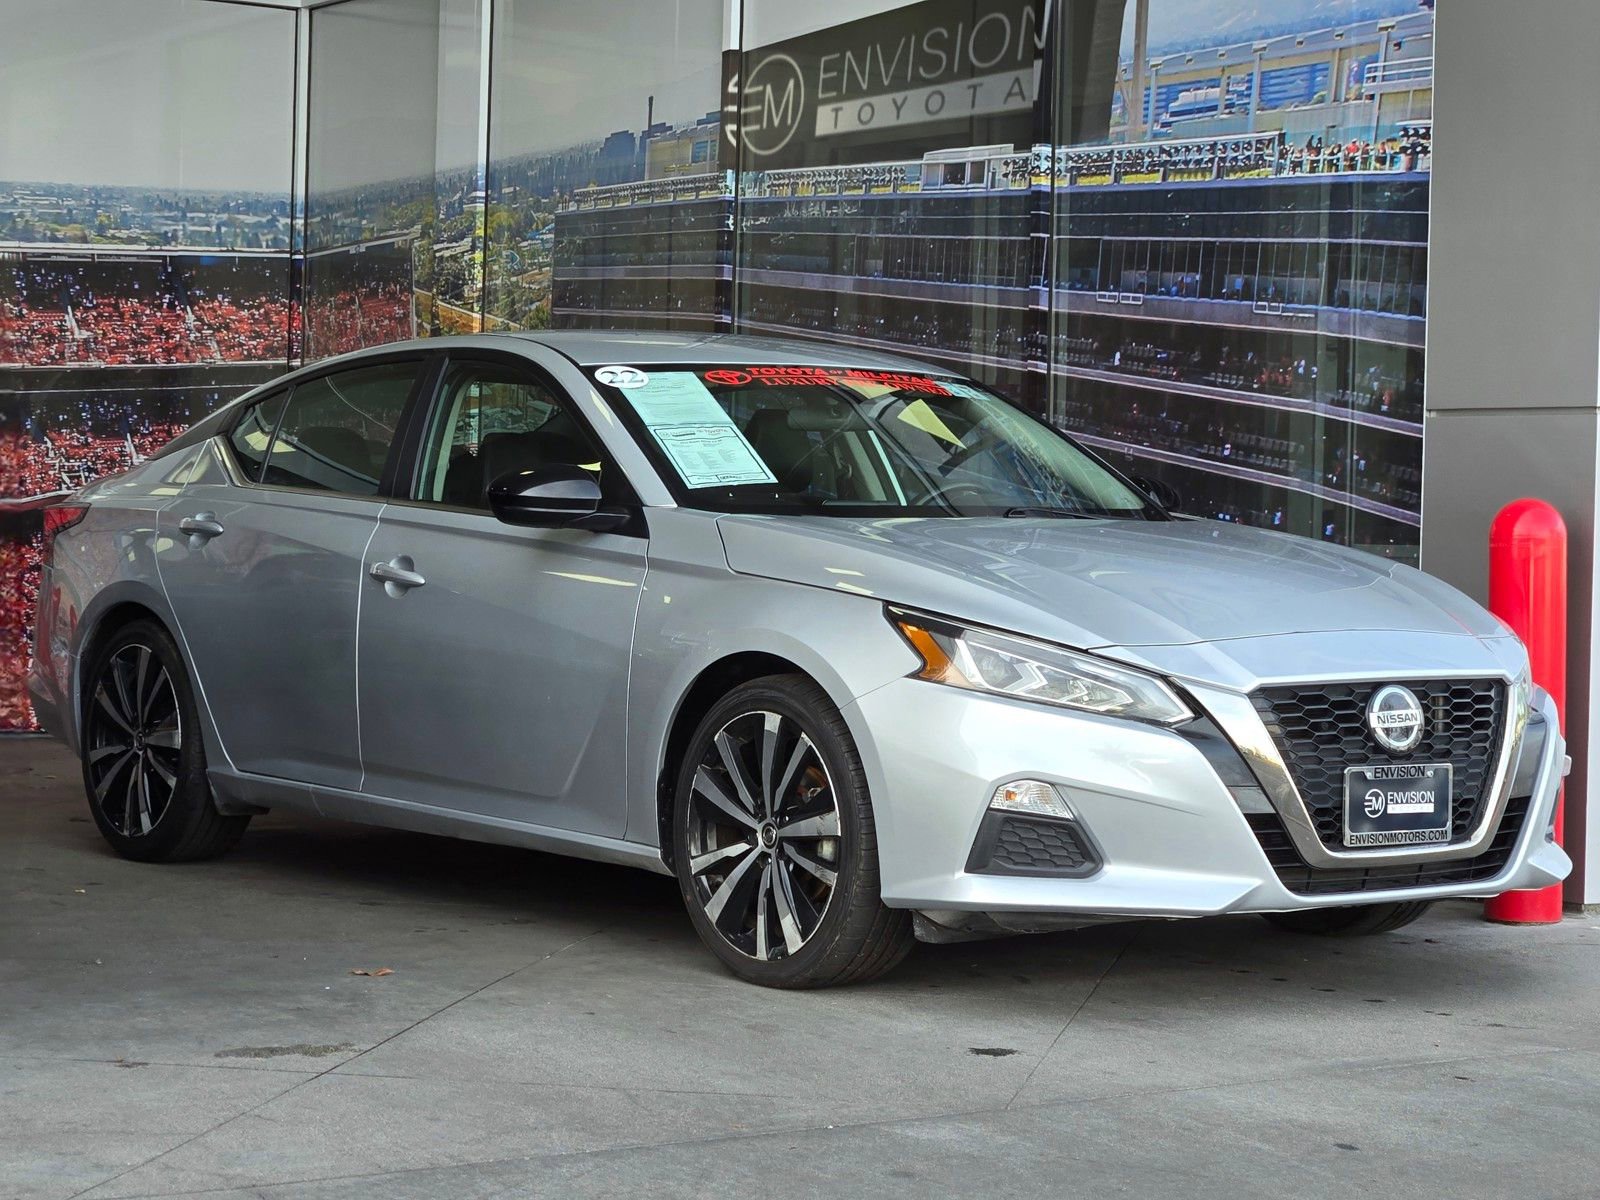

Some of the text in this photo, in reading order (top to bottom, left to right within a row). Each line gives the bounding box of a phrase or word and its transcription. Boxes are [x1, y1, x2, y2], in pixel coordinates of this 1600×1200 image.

[818, 2, 1047, 99] ENVISION
[831, 76, 1027, 130] TOYOTA
[600, 369, 645, 384] 22
[746, 367, 828, 376] TOYOTA
[1377, 713, 1418, 725] NISSAN
[1374, 766, 1426, 779] ENVISION
[1387, 791, 1435, 804] ENVISION
[1349, 830, 1448, 845] ENVISIONMOTORS.COM
